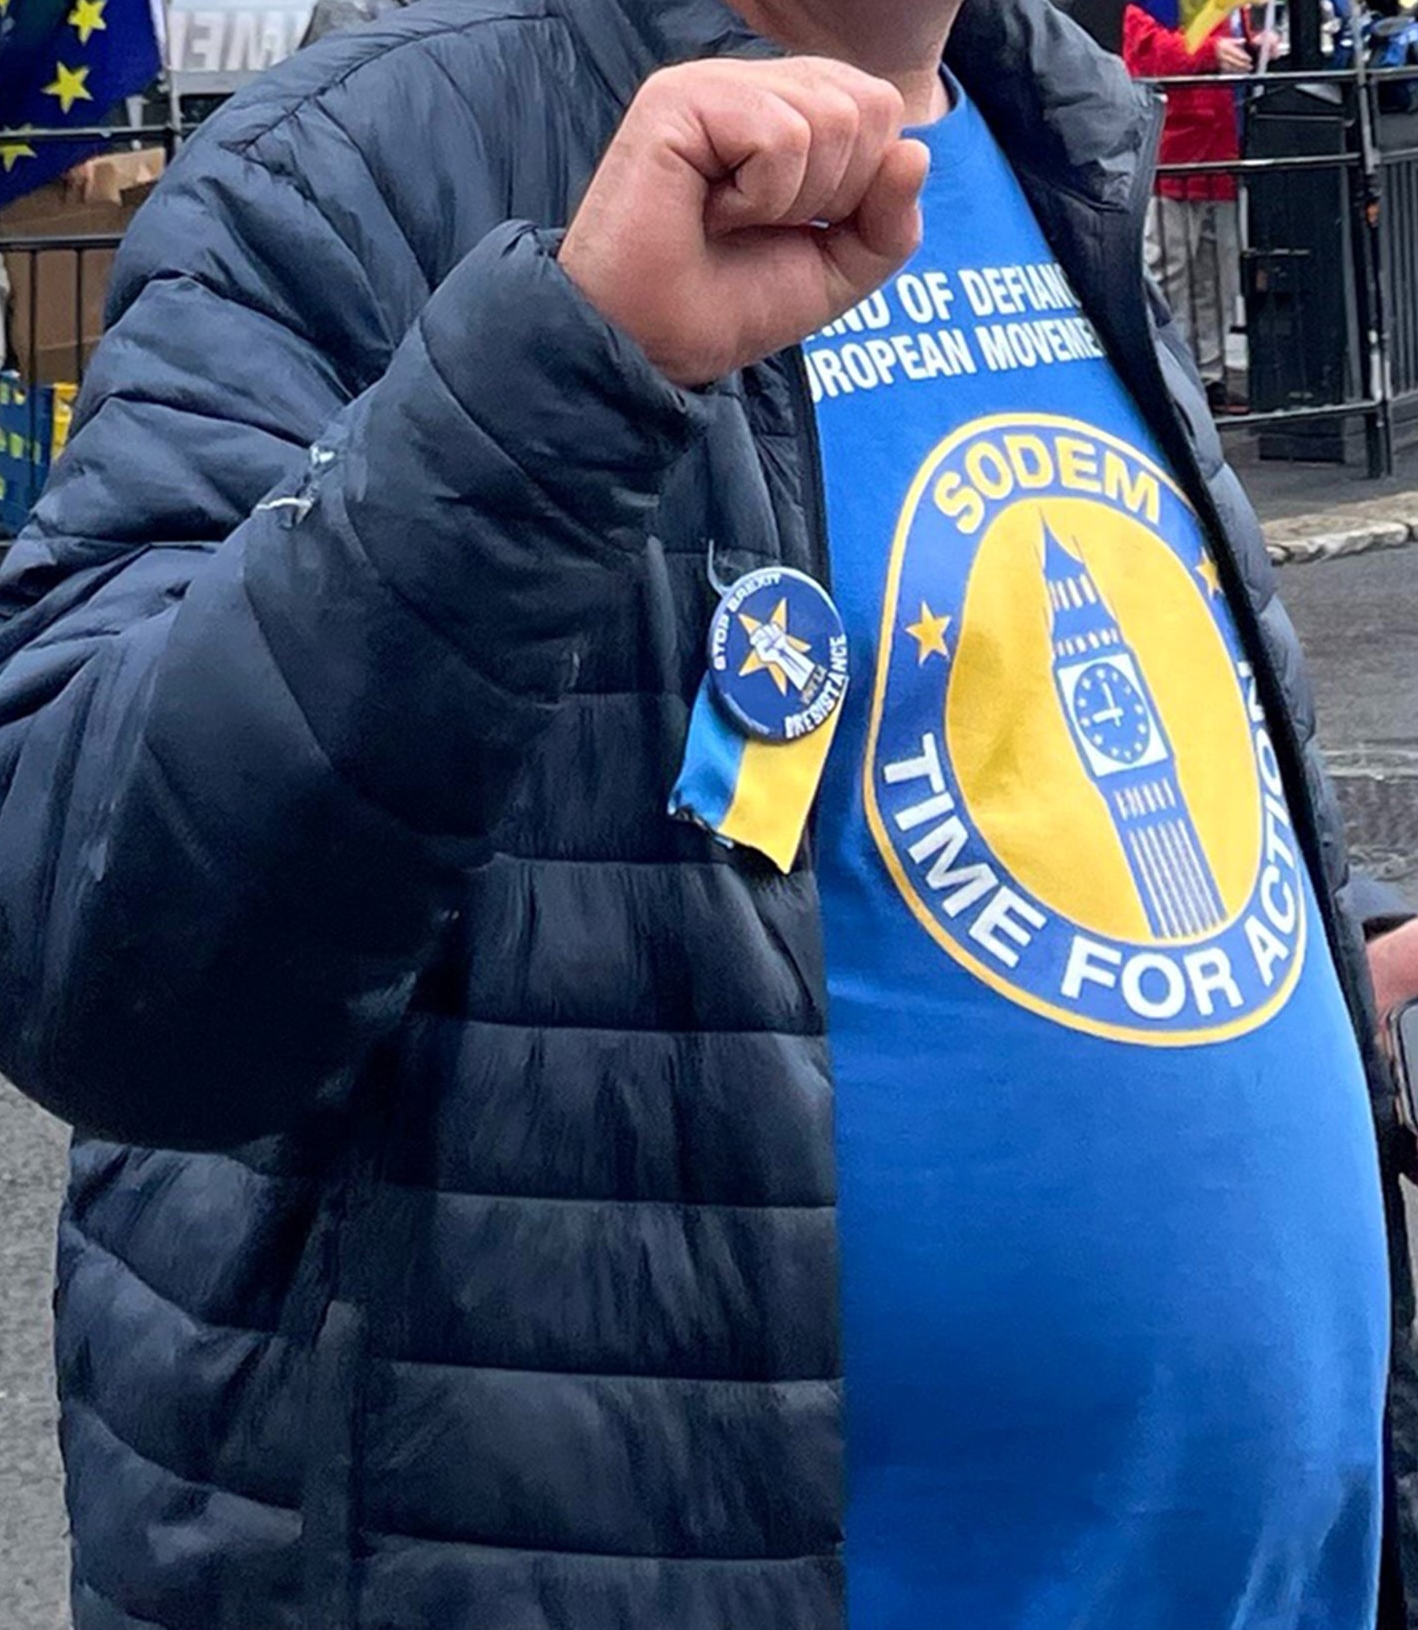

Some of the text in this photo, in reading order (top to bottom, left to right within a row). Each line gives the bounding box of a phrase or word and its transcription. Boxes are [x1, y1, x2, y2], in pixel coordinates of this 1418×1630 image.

[896, 272, 954, 323] OF
[976, 316, 1107, 372] MOVEME
[933, 434, 1162, 536] SODEM
[713, 573, 782, 670] STOP BREXIT
[883, 733, 1047, 968] TIME
[1060, 940, 1244, 1021] FOR
